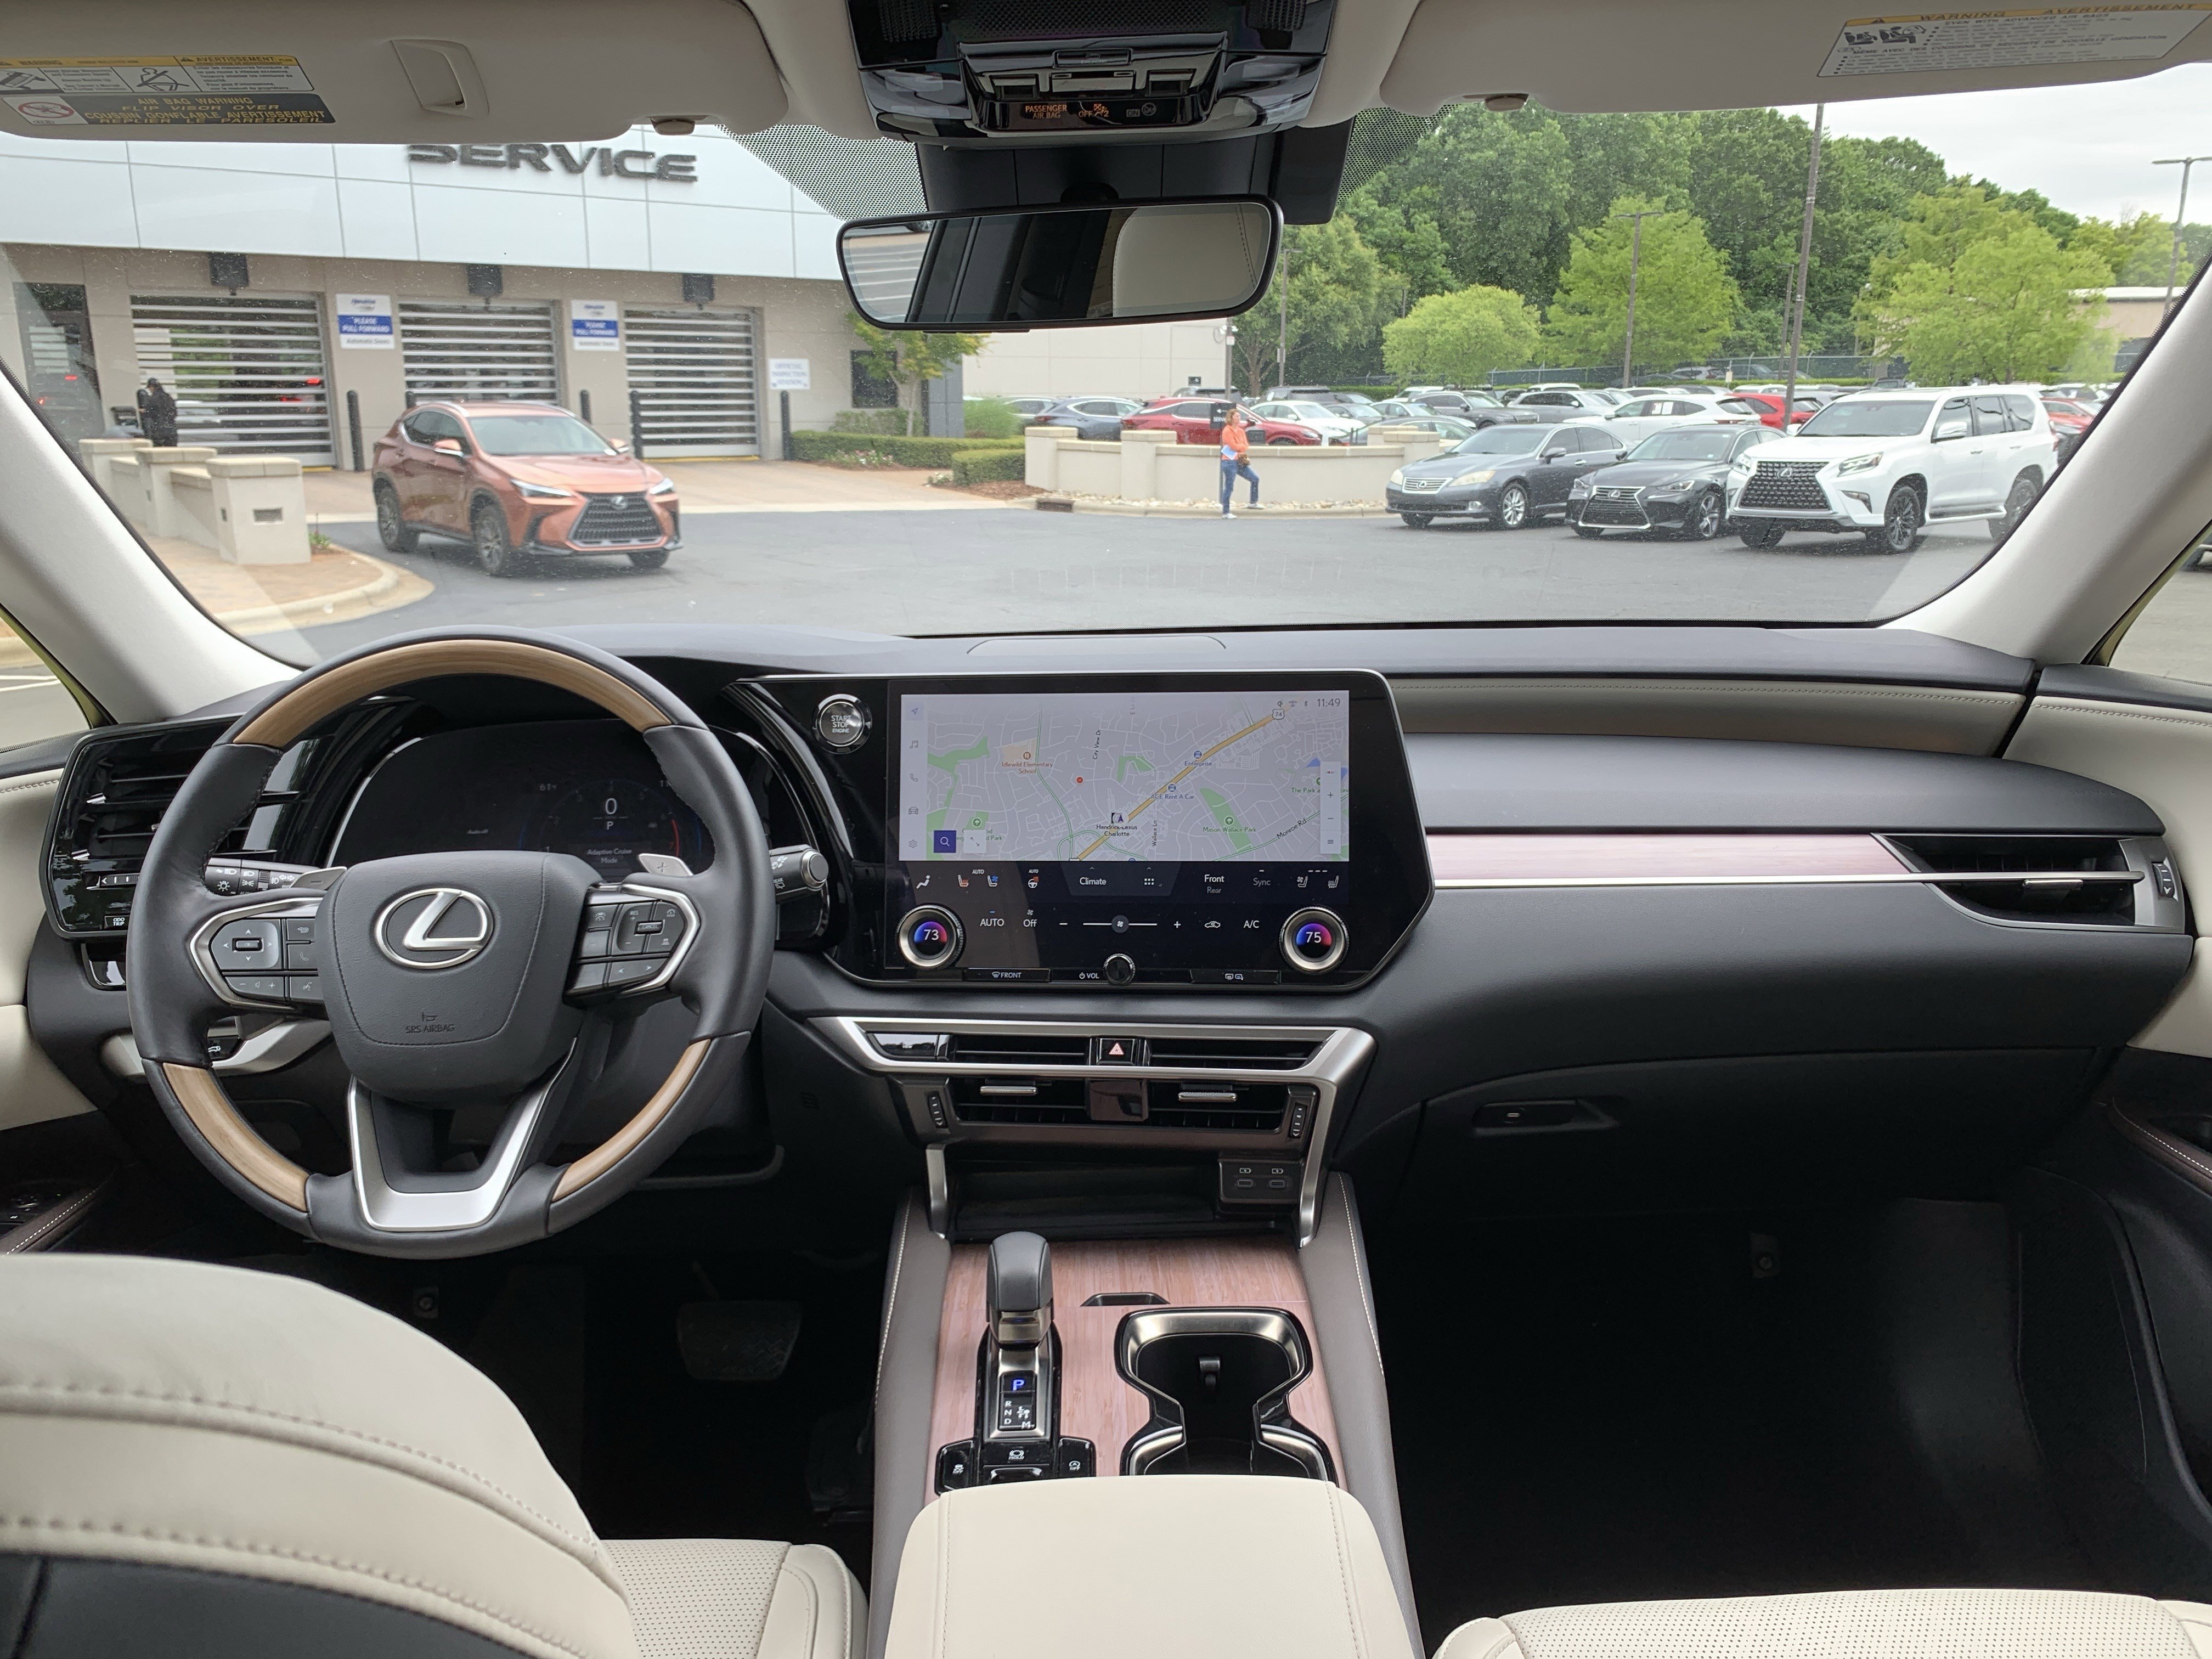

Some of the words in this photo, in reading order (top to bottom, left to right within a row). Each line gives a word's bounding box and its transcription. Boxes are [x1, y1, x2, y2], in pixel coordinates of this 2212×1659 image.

[1025, 104, 1067, 113] PASSENGER
[408, 144, 698, 183] SERVICE
[1317, 698, 1341, 707] 11:49
[605, 797, 618, 815] 0
[606, 821, 614, 830] P
[1277, 825, 1298, 839] Monroe
[1297, 817, 1307, 827] Rd
[1079, 877, 1107, 885] Climate
[1204, 874, 1224, 883] Front
[1253, 877, 1271, 887] Sync
[980, 918, 1005, 927] AUTO
[1023, 918, 1037, 927] Off
[1243, 920, 1260, 929] A/C
[923, 929, 939, 941] 73
[1306, 932, 1322, 944] 75
[405, 1024, 422, 1034] SRS
[424, 1024, 455, 1032] AIRBAG
[1012, 1379, 1025, 1391] P
